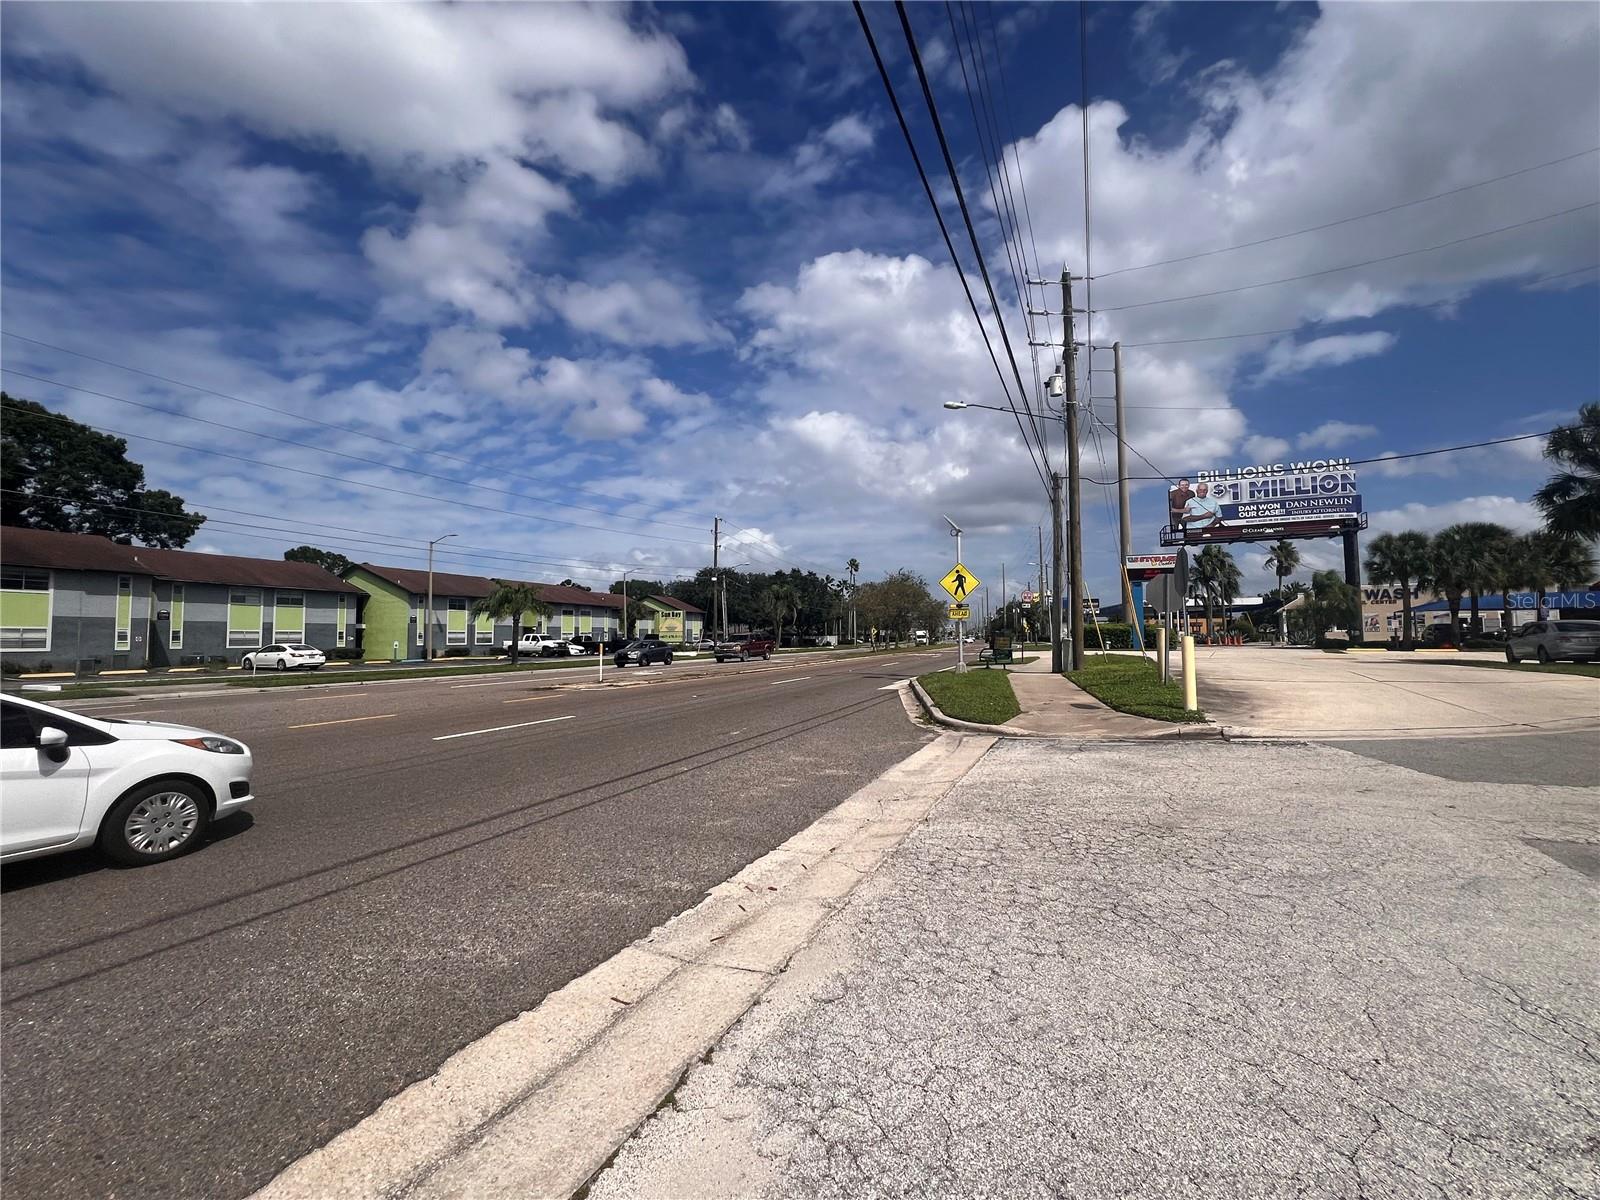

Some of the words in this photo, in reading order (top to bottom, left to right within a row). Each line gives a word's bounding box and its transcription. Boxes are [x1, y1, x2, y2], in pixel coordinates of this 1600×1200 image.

[1197, 463, 1284, 483] BILLIONS
[1290, 458, 1350, 475] WON!
[1212, 482, 1241, 501] $1
[1248, 472, 1357, 500] MILLION
[1238, 504, 1257, 512] DAN
[1258, 502, 1281, 510] WON
[1286, 500, 1308, 508] DAN
[1310, 497, 1353, 506] NEWLIN
